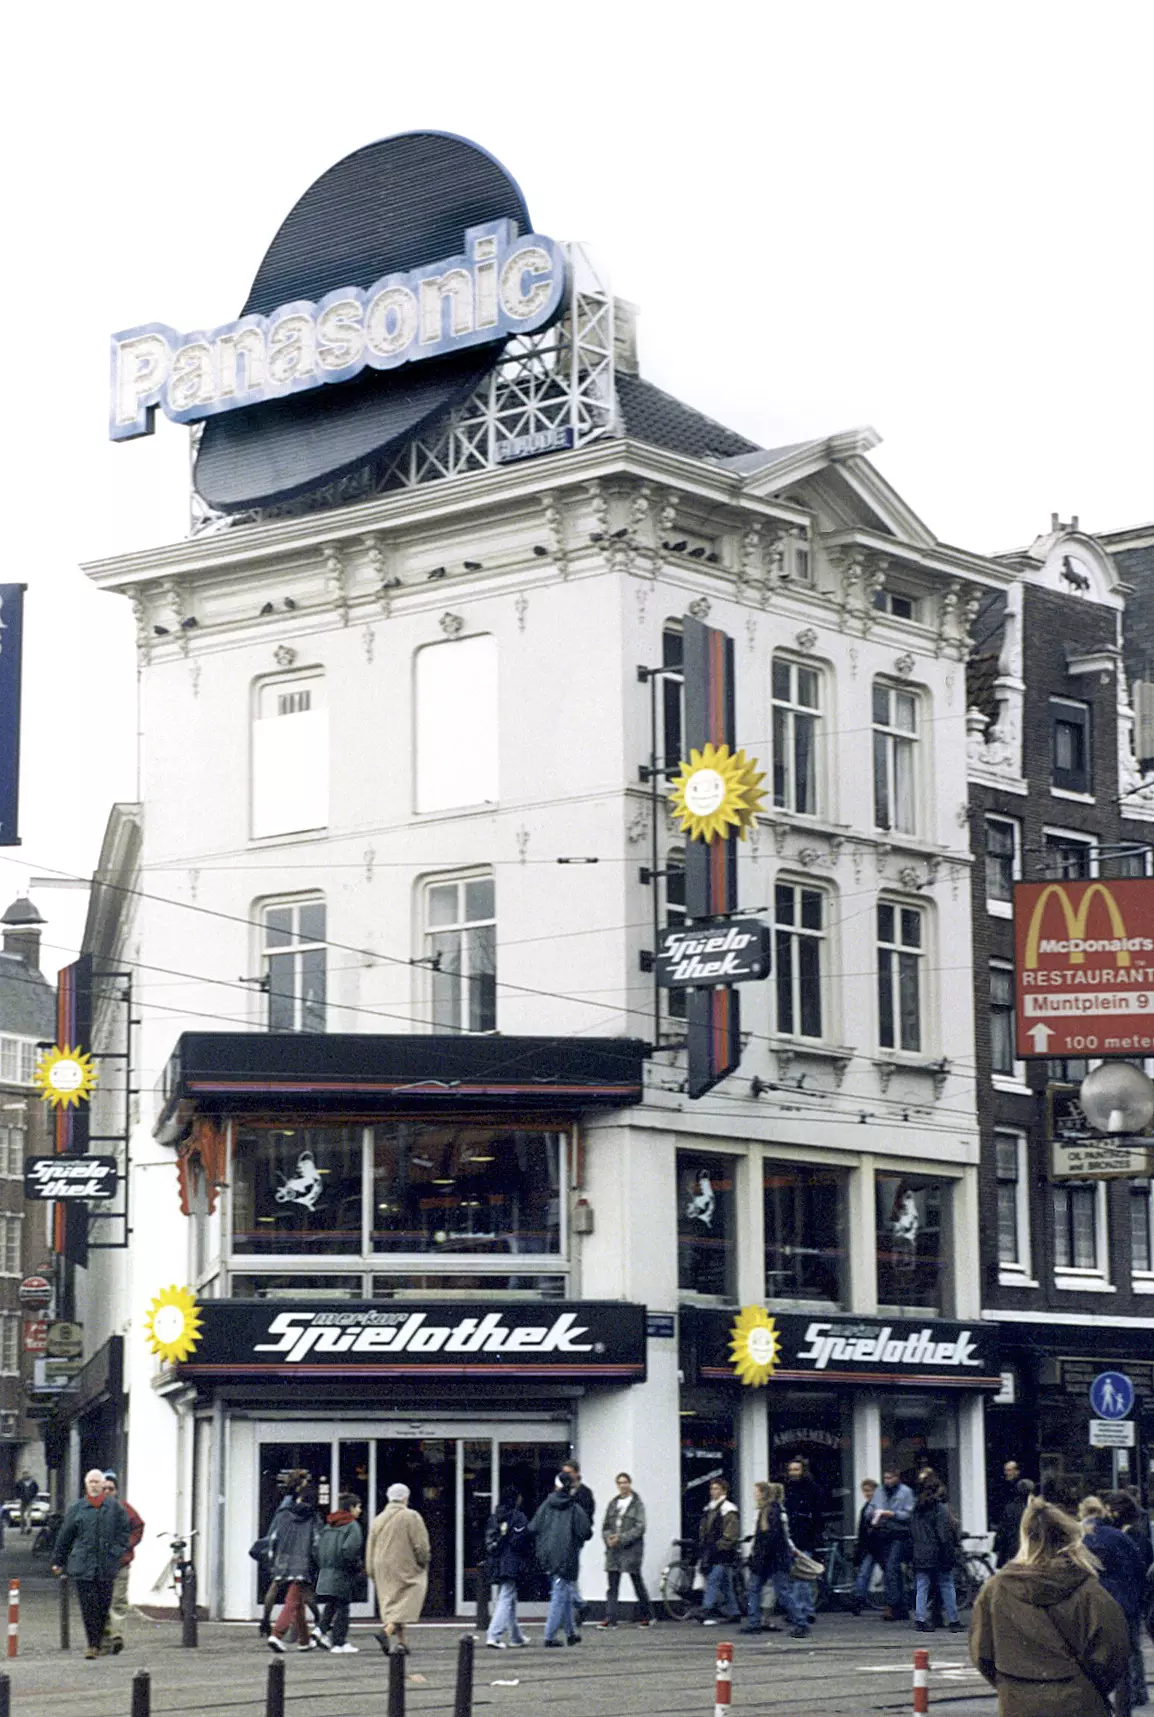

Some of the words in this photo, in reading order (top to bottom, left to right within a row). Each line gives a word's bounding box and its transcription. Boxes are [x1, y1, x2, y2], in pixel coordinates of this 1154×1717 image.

[112, 230, 557, 428] Panasonic
[1039, 937, 1153, 953] McDonald's
[666, 952, 751, 980] thek
[1022, 968, 1154, 986] RESTAURANT
[1032, 994, 1130, 1013] Muntplein
[1136, 993, 1149, 1009] 9
[1064, 1036, 1098, 1049] 100
[1104, 1034, 1154, 1049] mete
[34, 1179, 110, 1197] thek
[253, 1312, 594, 1362] Spielothek
[796, 1323, 982, 1369] Spielothek
